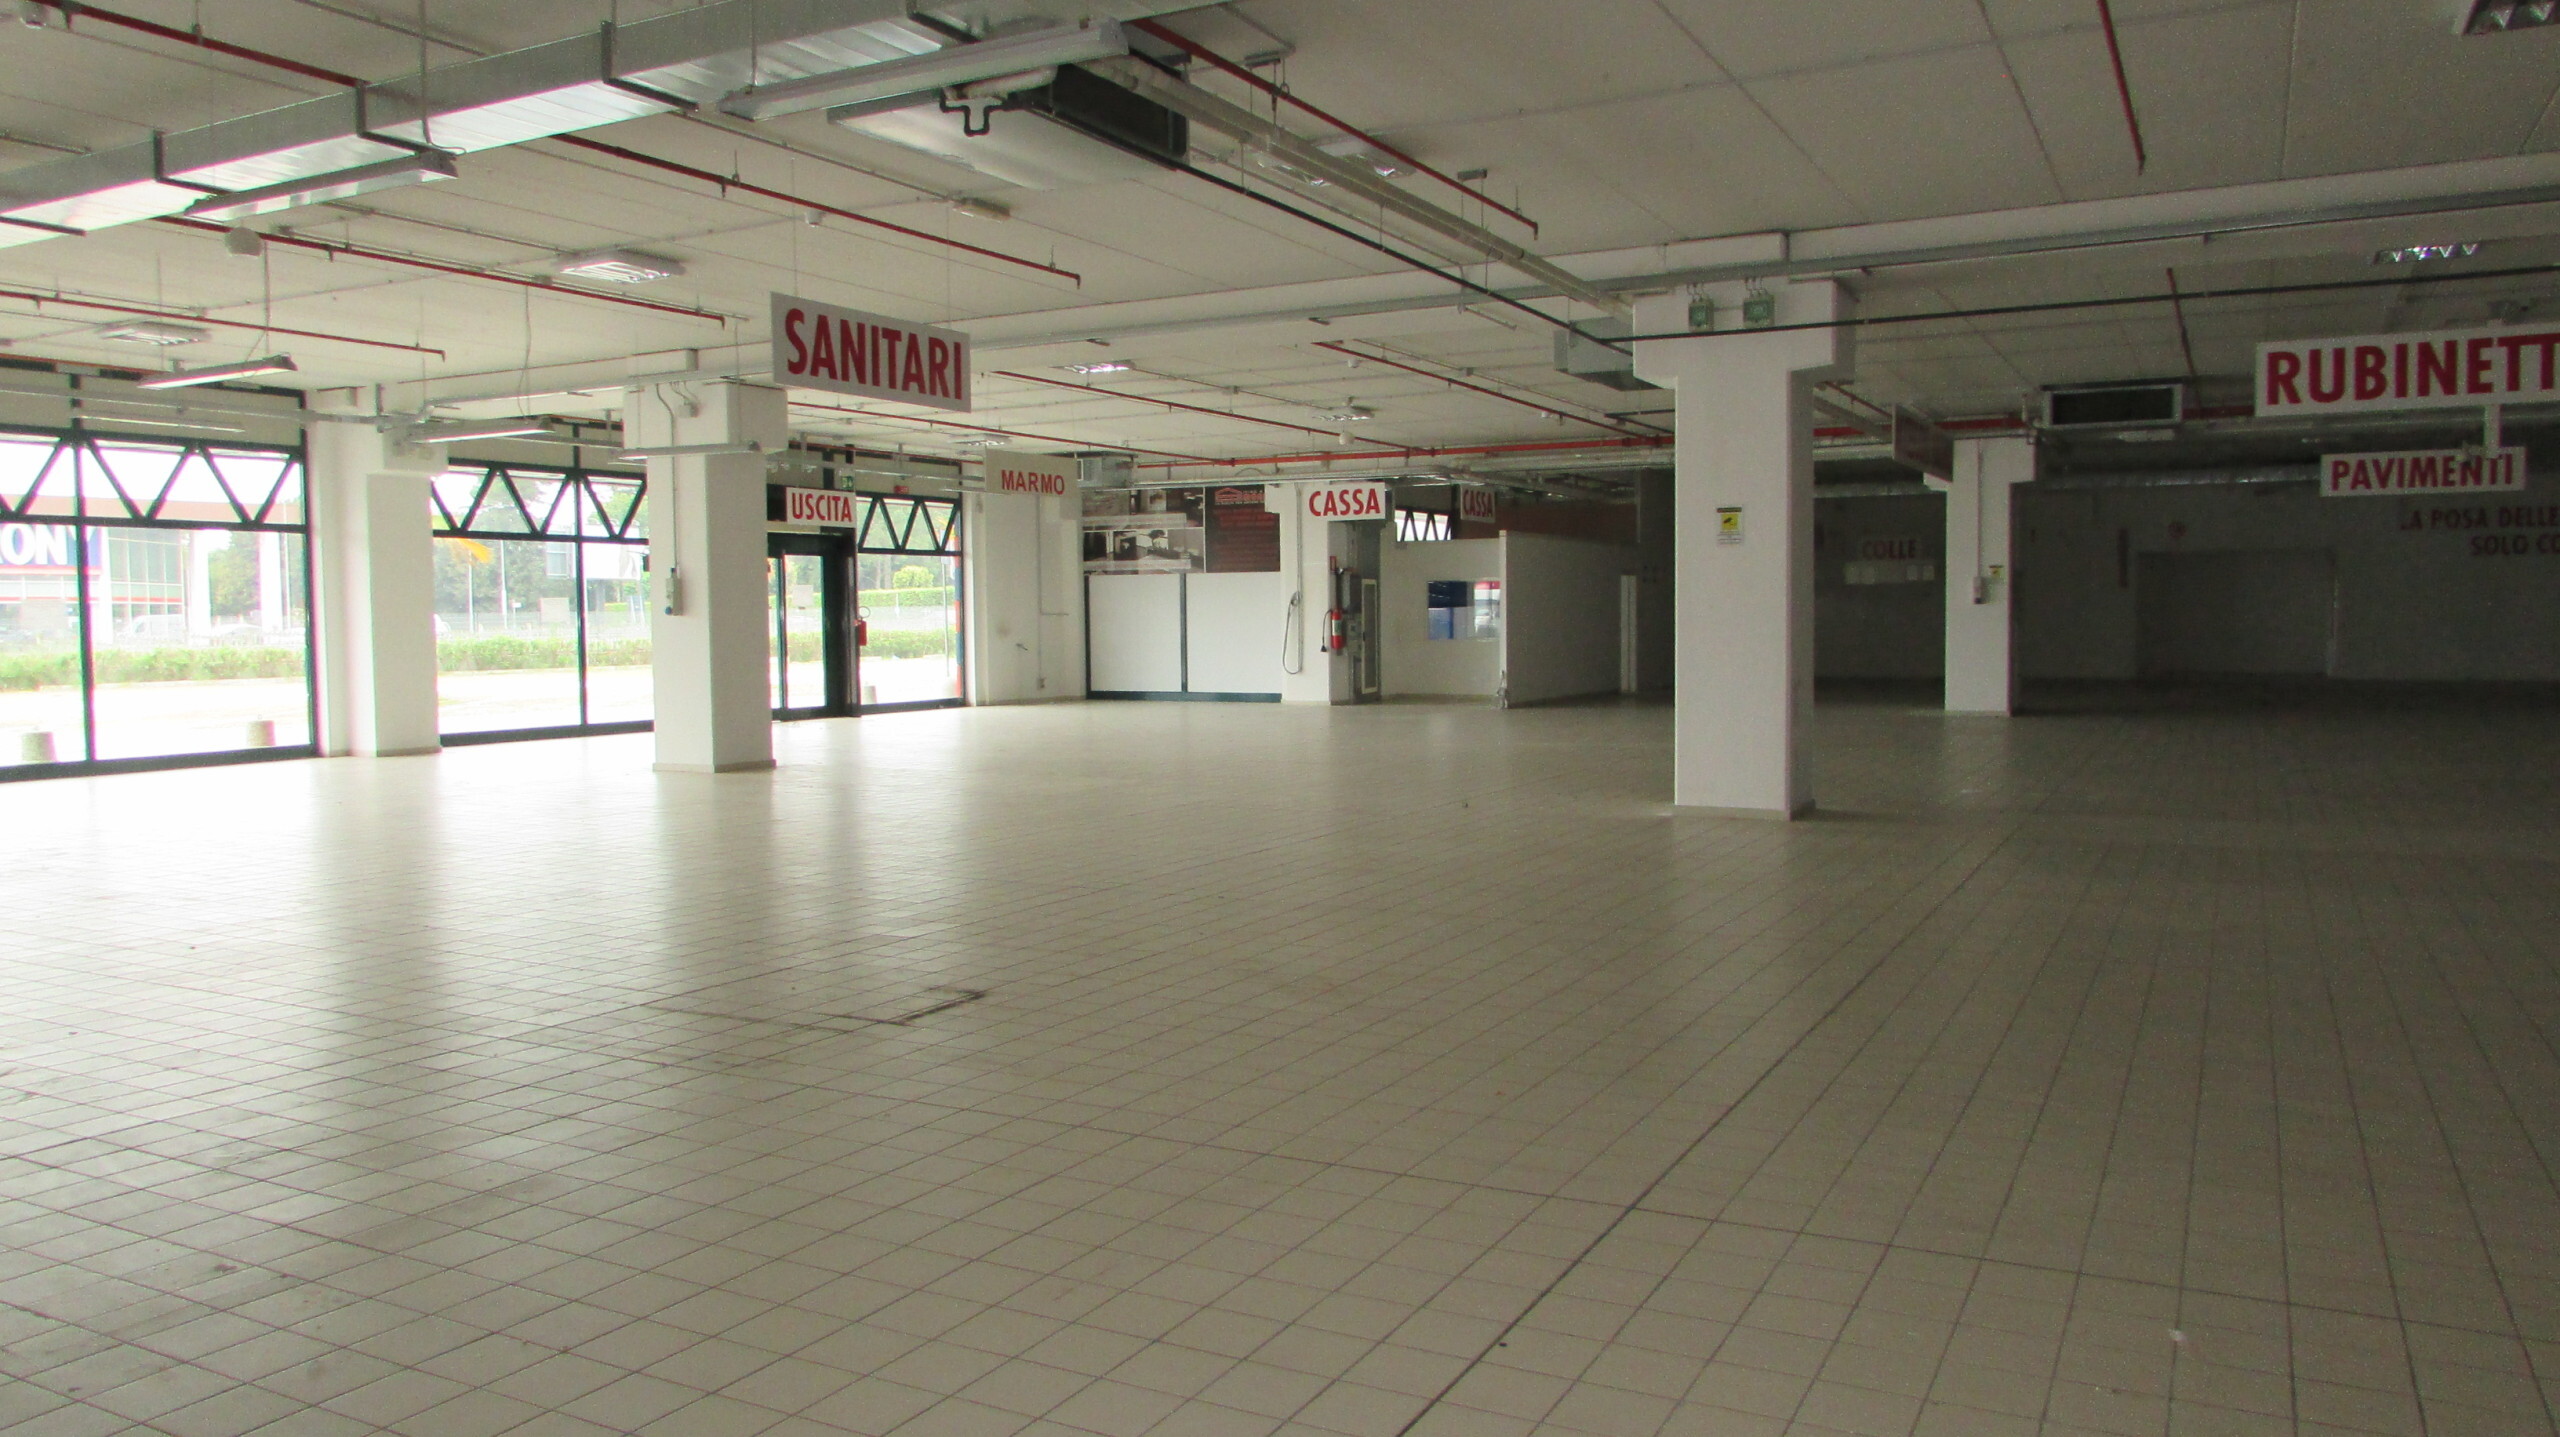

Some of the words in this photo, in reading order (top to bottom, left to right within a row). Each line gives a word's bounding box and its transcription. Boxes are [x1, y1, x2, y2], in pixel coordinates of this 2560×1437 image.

[784, 307, 962, 400] SANITARI
[1001, 469, 1065, 495] MARMO
[2331, 453, 2513, 492] PAVIMENTI
[791, 492, 852, 522] USCITA
[1309, 488, 1381, 517] CASSA
[1463, 488, 1494, 518] CASSA
[2431, 507, 2488, 530] POSA
[1862, 539, 1917, 560] COLLE
[2470, 534, 2529, 556] SOLO
